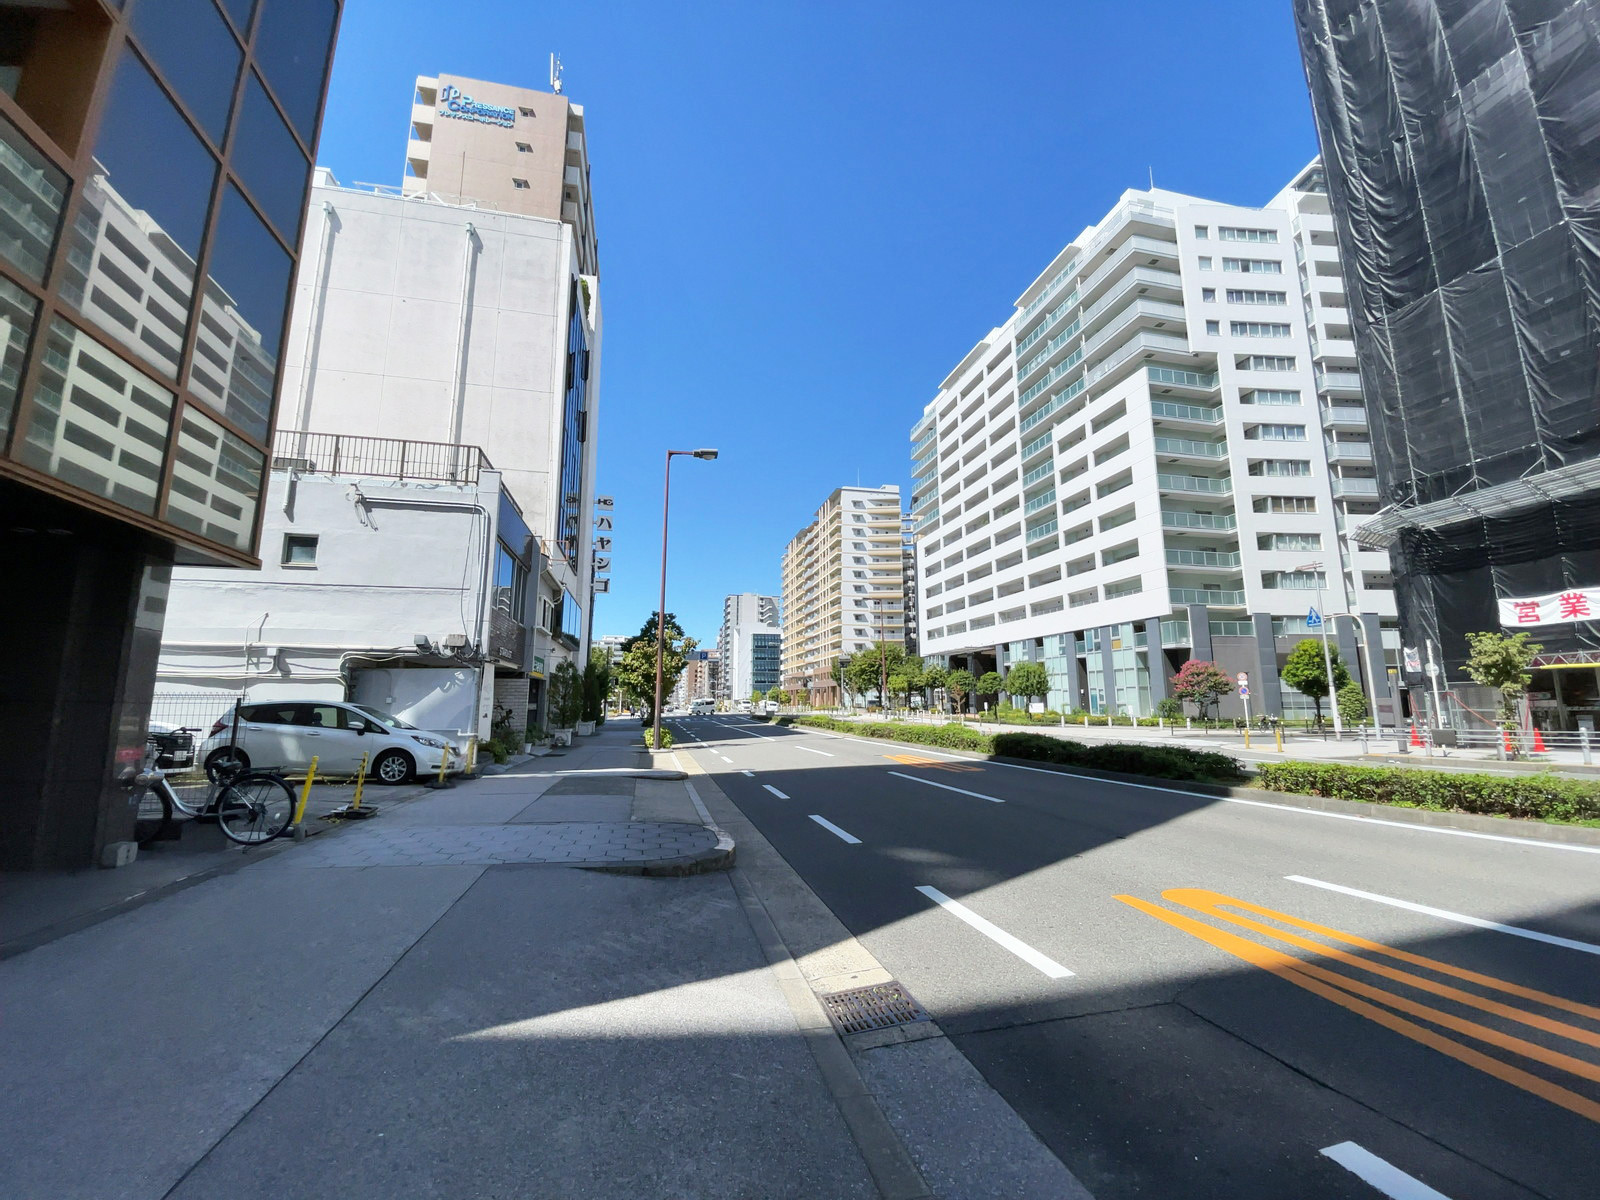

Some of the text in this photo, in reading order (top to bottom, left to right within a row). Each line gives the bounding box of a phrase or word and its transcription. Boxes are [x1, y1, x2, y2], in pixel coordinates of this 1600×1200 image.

[447, 99, 515, 121] CORPORATION
[461, 95, 515, 114] PRESSANCE
[1513, 591, 1591, 624] 営業
